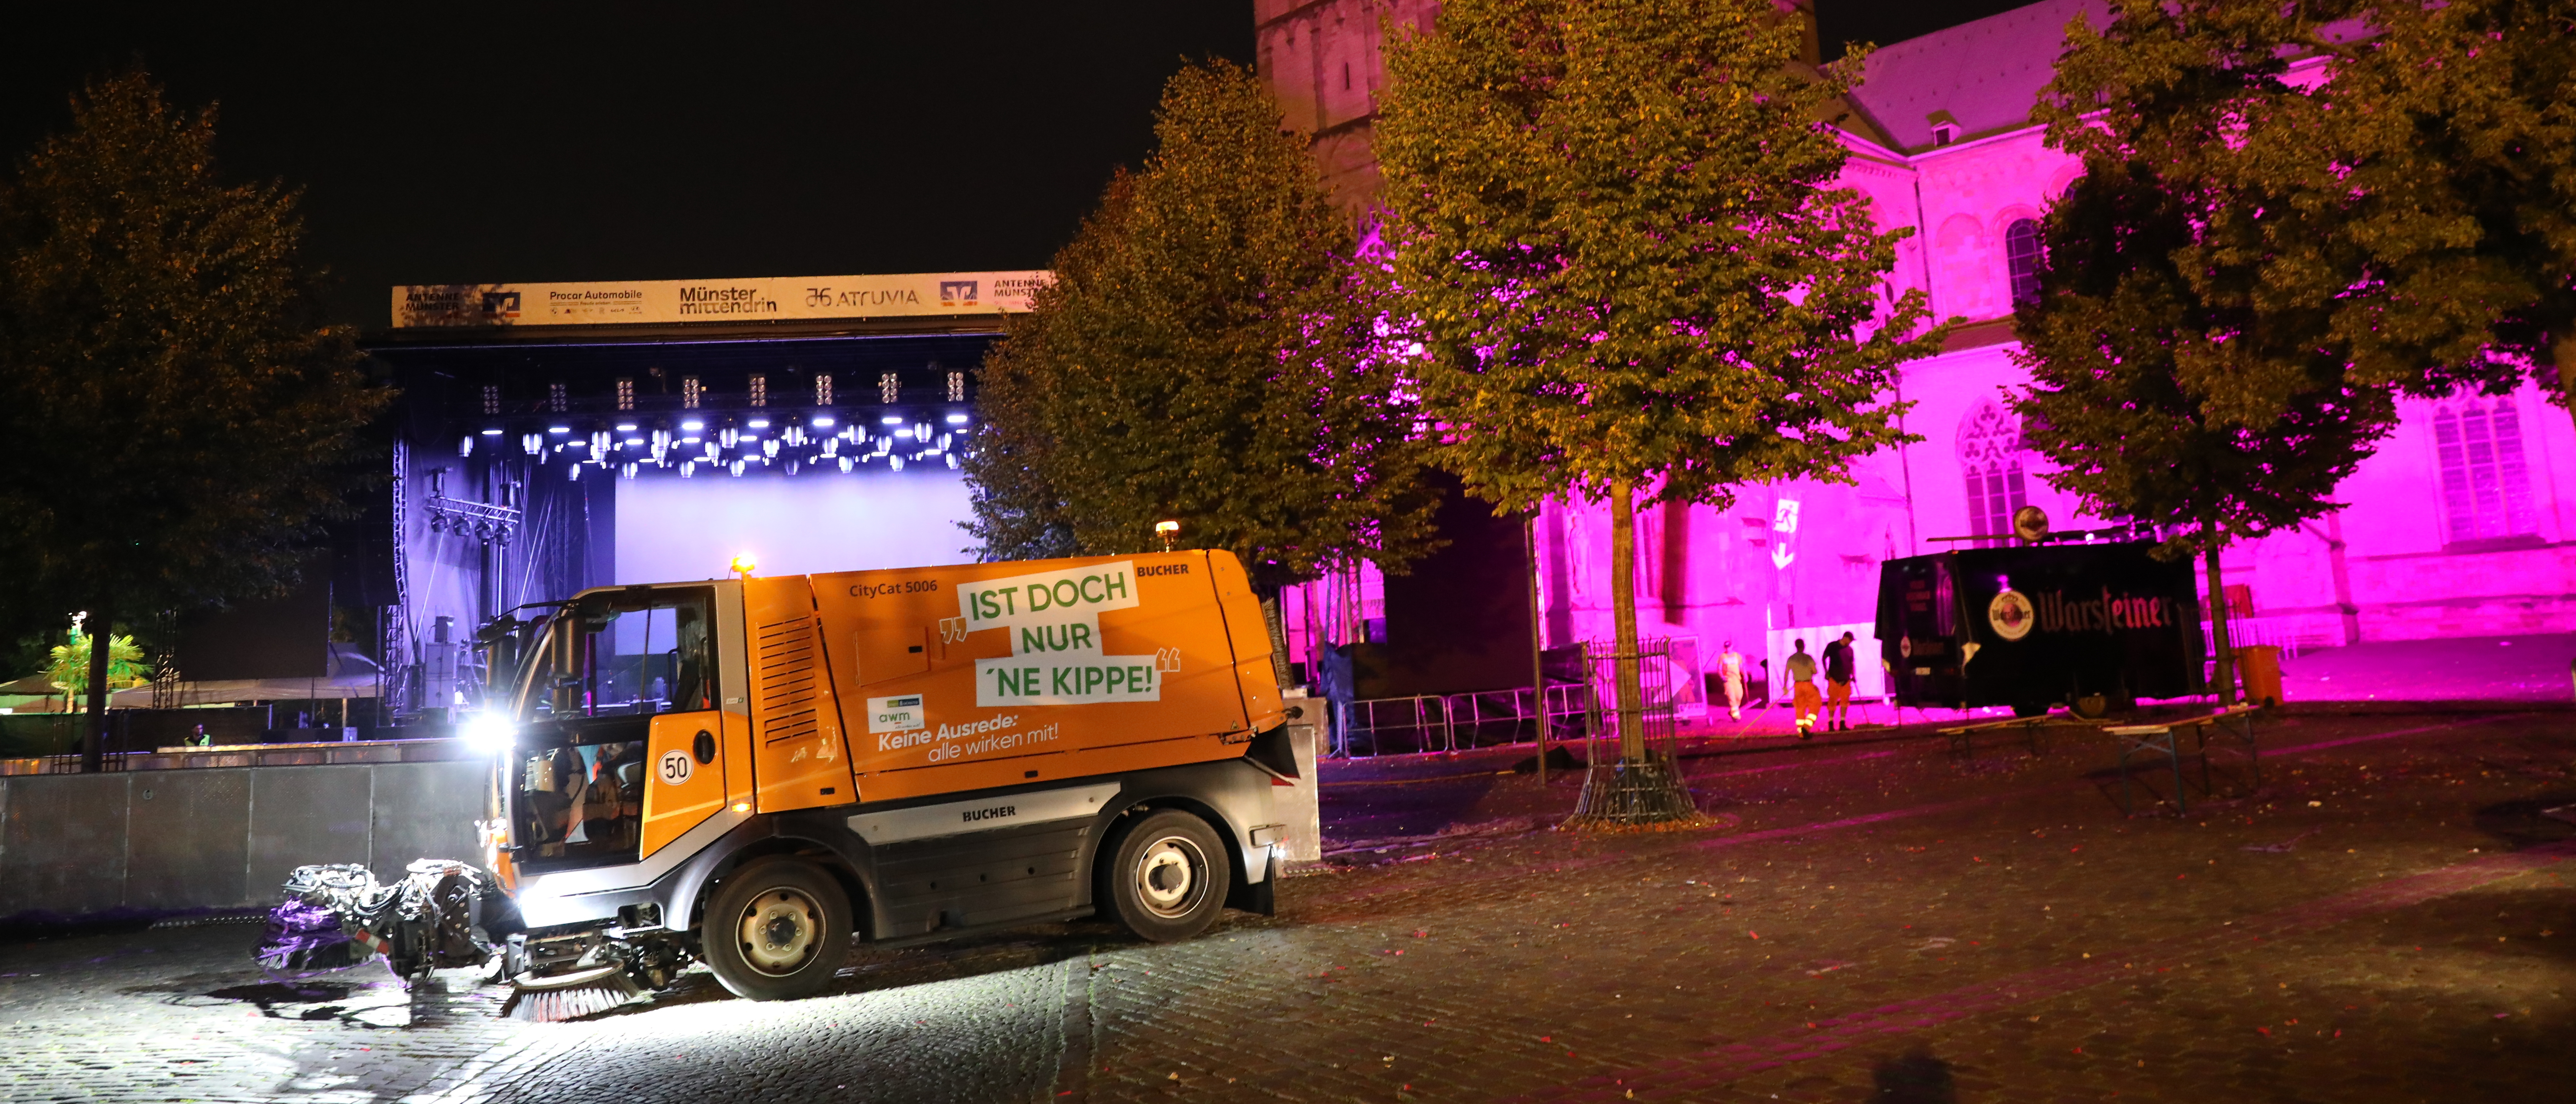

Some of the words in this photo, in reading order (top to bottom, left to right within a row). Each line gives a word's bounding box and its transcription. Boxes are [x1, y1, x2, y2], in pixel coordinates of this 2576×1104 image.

[406, 293, 459, 302] ANTENNE
[550, 292, 582, 300] Procar
[585, 290, 642, 299] Automobile
[680, 287, 757, 302] Münster
[405, 302, 459, 311] MÜNSTER
[680, 297, 777, 314] mittendrin
[1137, 564, 1189, 577] BUCHER
[849, 583, 902, 599] CityCat
[905, 580, 937, 593] 5006
[970, 587, 1018, 620] IST
[1027, 572, 1127, 612] DOCH
[2037, 585, 2172, 636] Warsteiner
[1021, 623, 1093, 654] NUR
[1052, 666, 1152, 695] KIPPE!
[879, 712, 910, 723] awm
[878, 730, 932, 752] Keine
[935, 713, 1019, 742] Ausrede:
[928, 742, 961, 763] alle
[965, 733, 1023, 755] wirken
[1027, 722, 1059, 744] mit!
[666, 757, 687, 779] 50
[962, 806, 1016, 822] BUCHER
